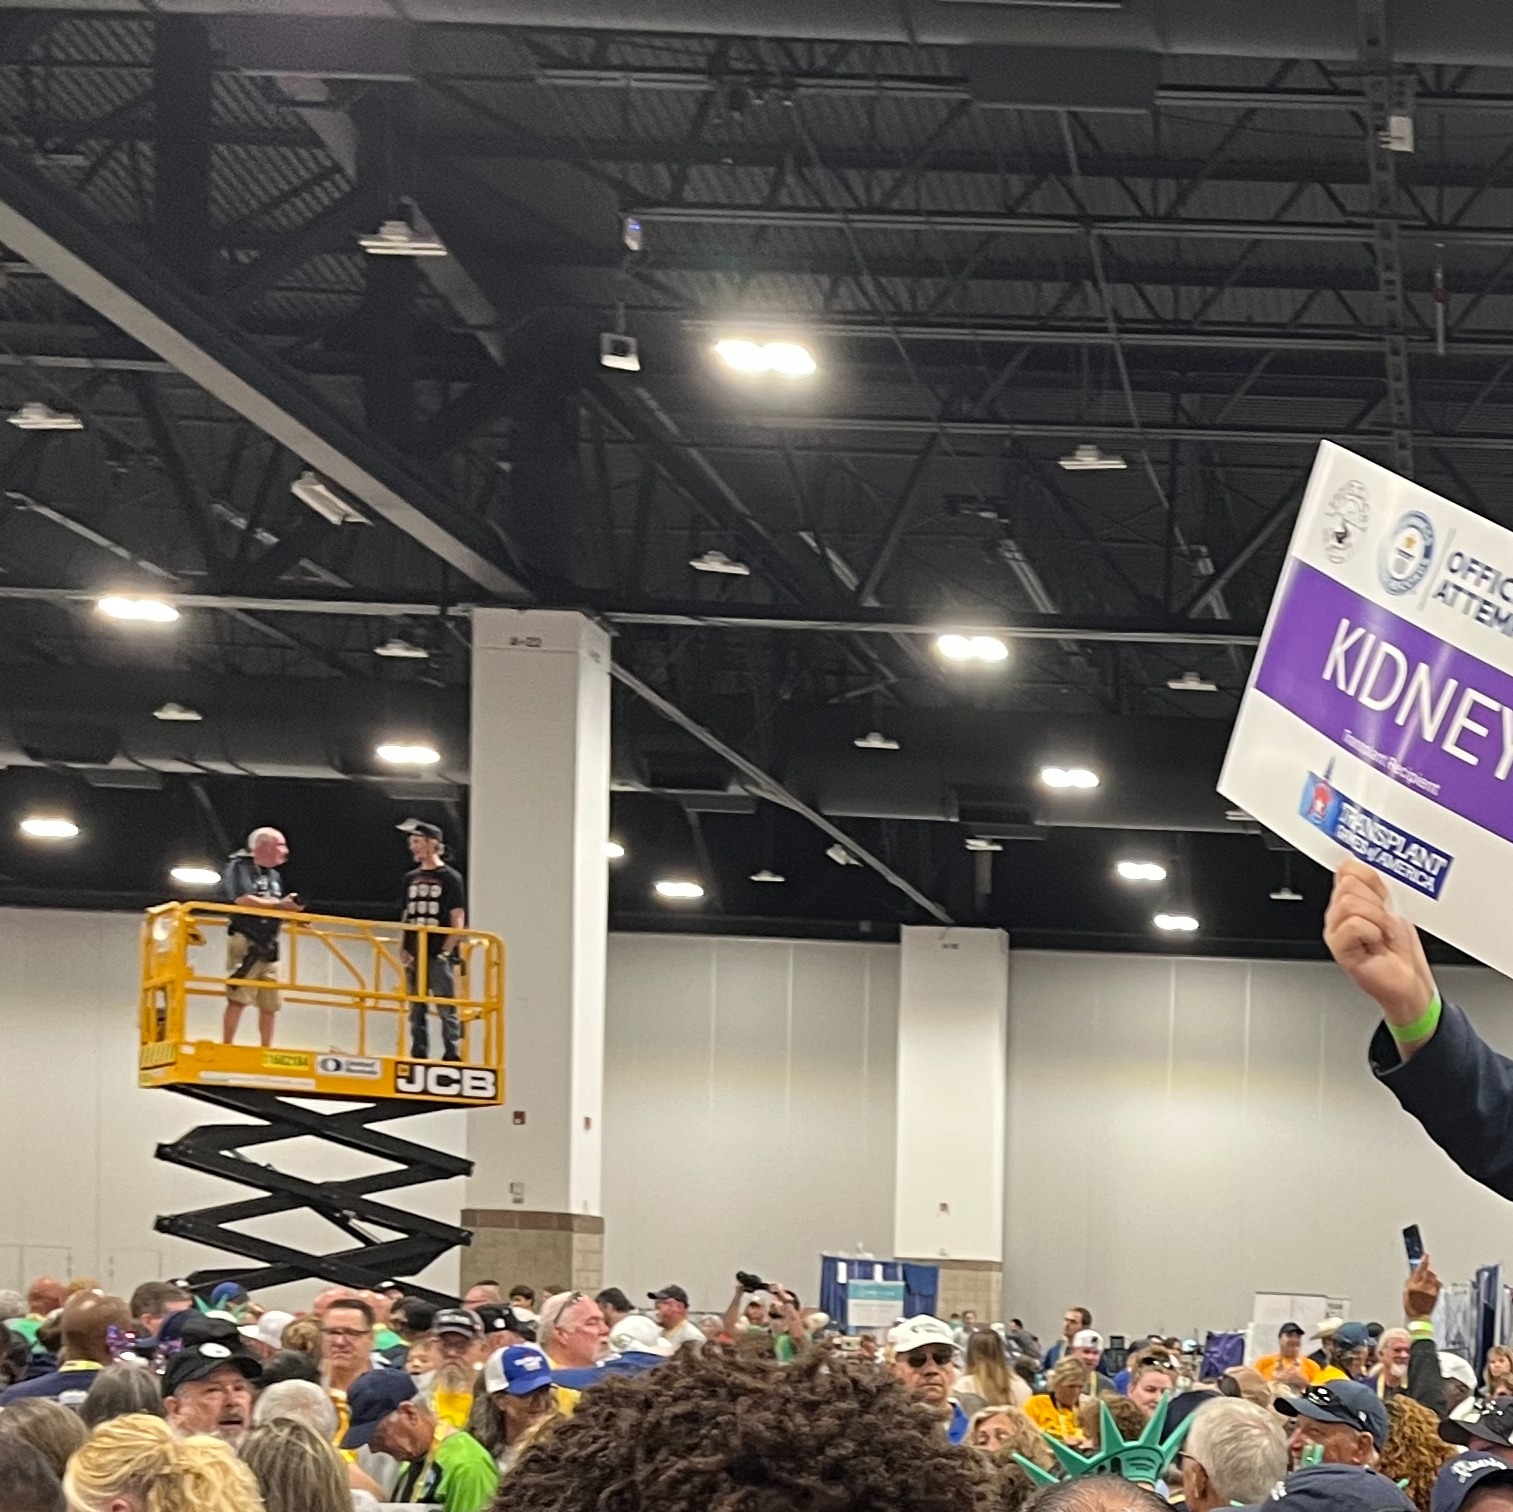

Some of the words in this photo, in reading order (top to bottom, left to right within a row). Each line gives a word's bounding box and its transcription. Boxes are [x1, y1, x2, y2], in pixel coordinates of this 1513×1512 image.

[1339, 801, 1449, 876] TRANSPLANT
[1376, 850, 1435, 893] AMERICA
[396, 1063, 496, 1098] JCB
